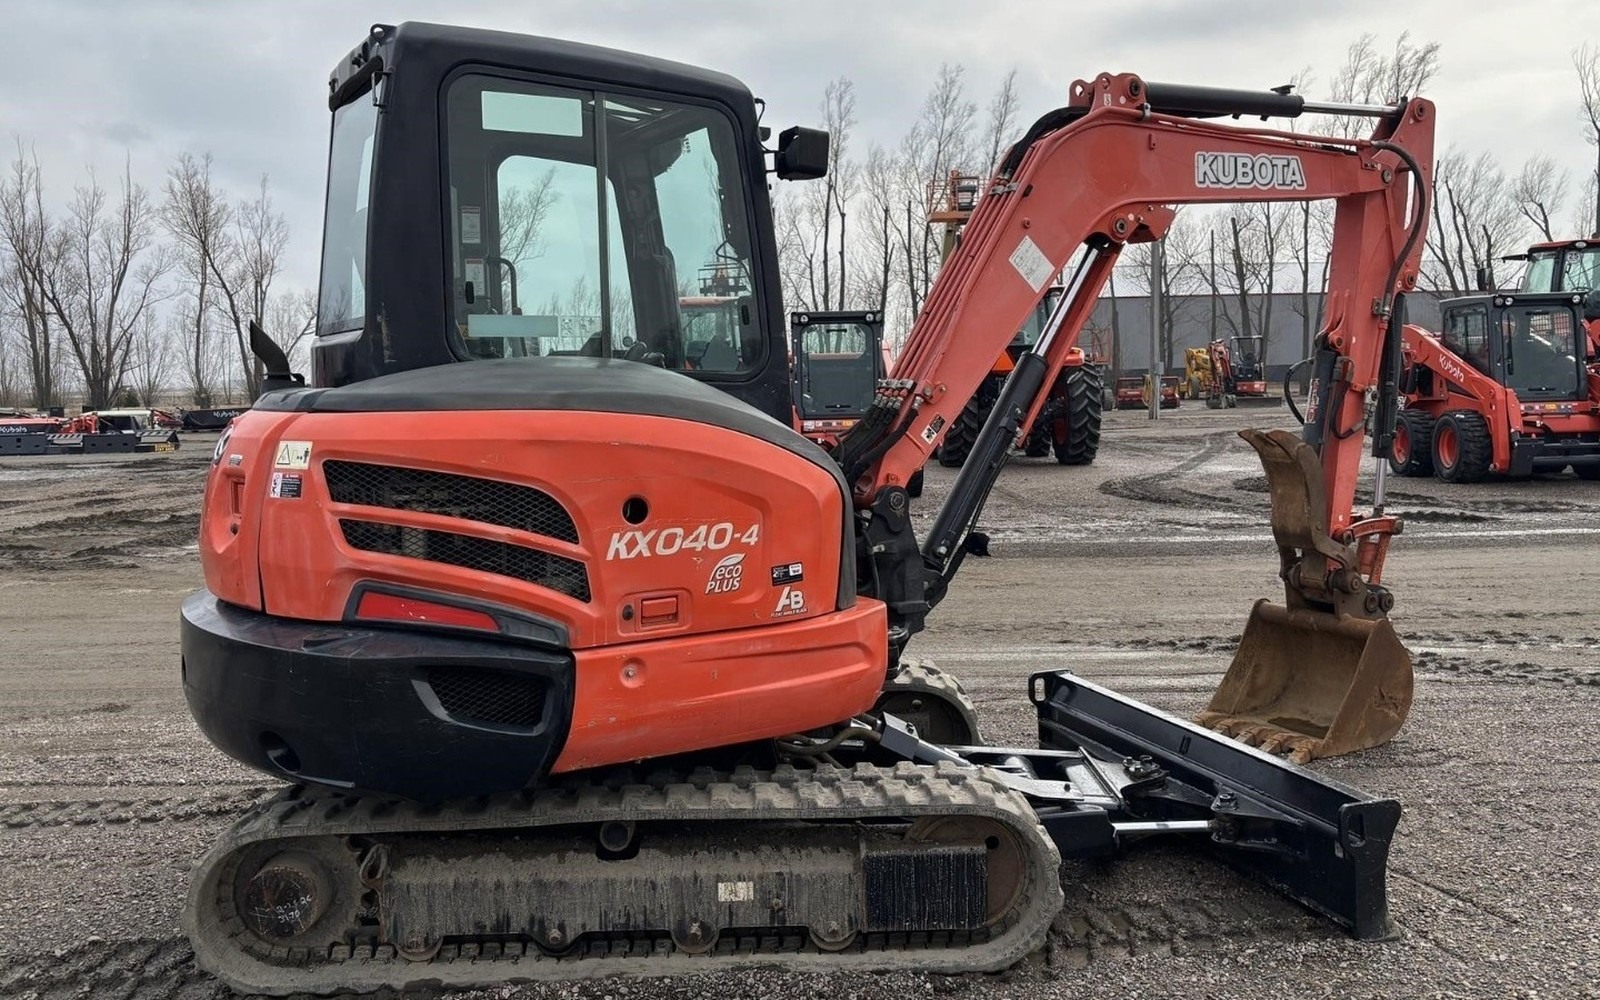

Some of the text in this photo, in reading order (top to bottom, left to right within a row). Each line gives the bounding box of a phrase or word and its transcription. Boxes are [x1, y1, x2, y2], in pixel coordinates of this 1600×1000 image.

[1196, 153, 1305, 188] KUBOTA
[1439, 353, 1465, 383] Kubota
[212, 410, 240, 418] Kubota
[0, 425, 28, 434] Kubota
[605, 522, 760, 561] KX040-4
[715, 564, 742, 580] eco
[705, 577, 741, 595] PLUS
[775, 586, 805, 612] AB
